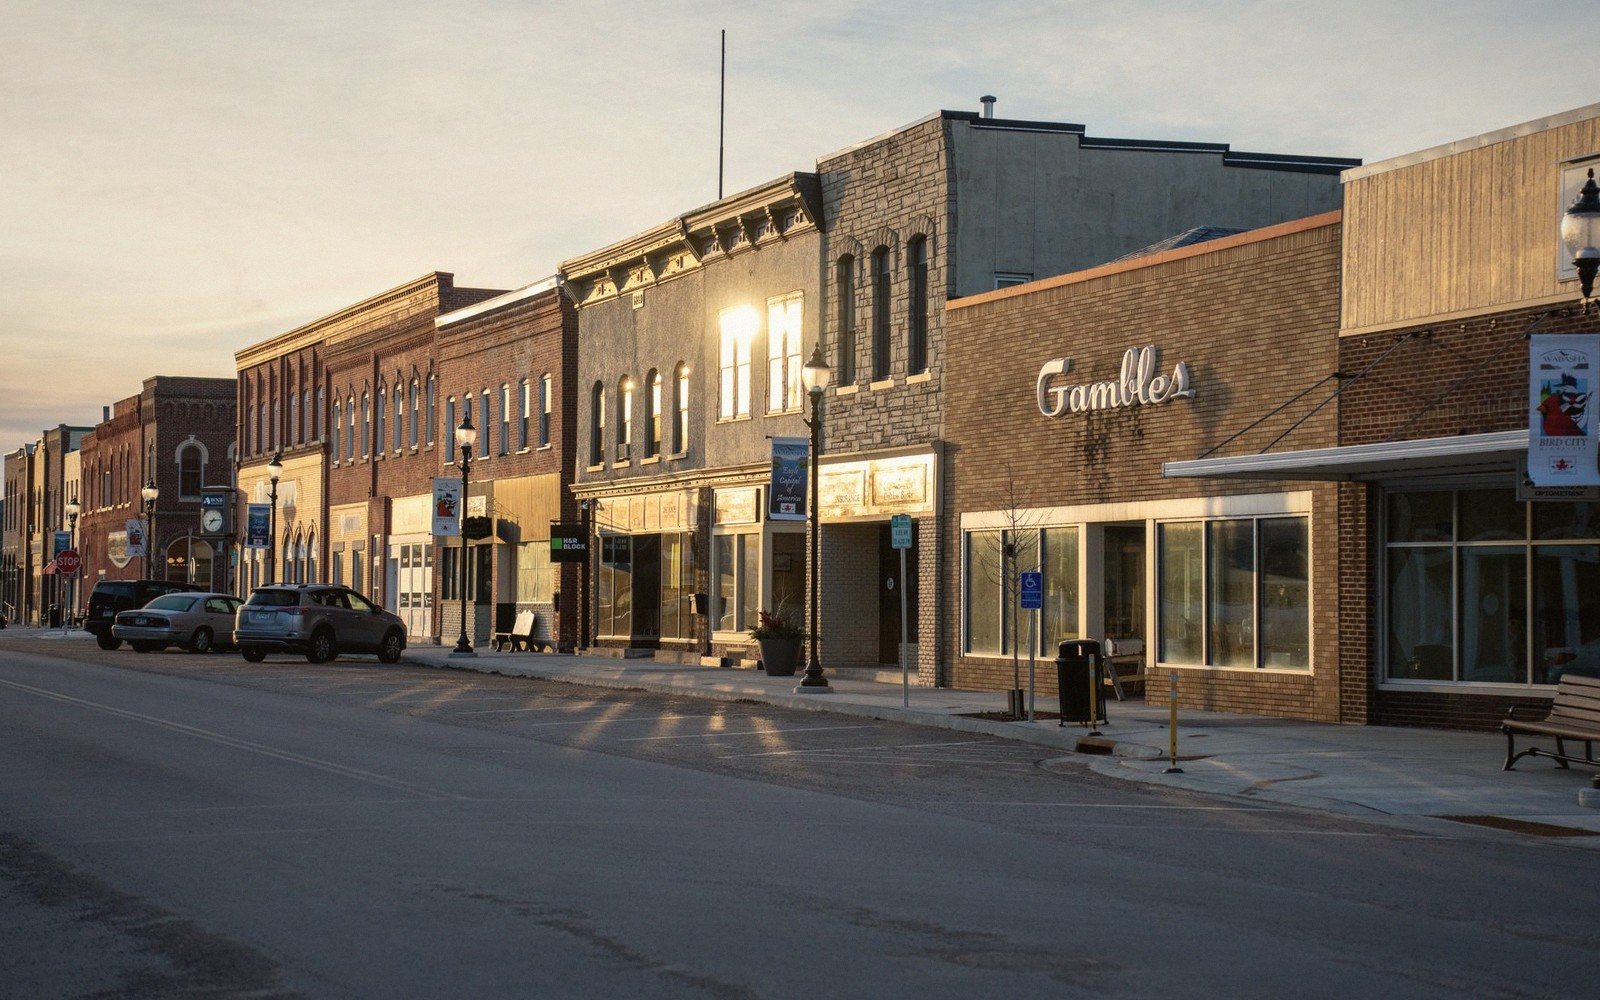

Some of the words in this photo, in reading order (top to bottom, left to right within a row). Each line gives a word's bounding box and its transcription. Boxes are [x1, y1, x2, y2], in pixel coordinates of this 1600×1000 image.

[1543, 354, 1587, 363] WABASHA
[1036, 345, 1196, 417] Gambles
[1539, 438, 1562, 447] BIRD
[1564, 438, 1588, 447] CITY
[782, 466, 799, 476] Eagle
[779, 476, 802, 487] Capital
[776, 494, 802, 502] America
[58, 556, 80, 566] STOP
